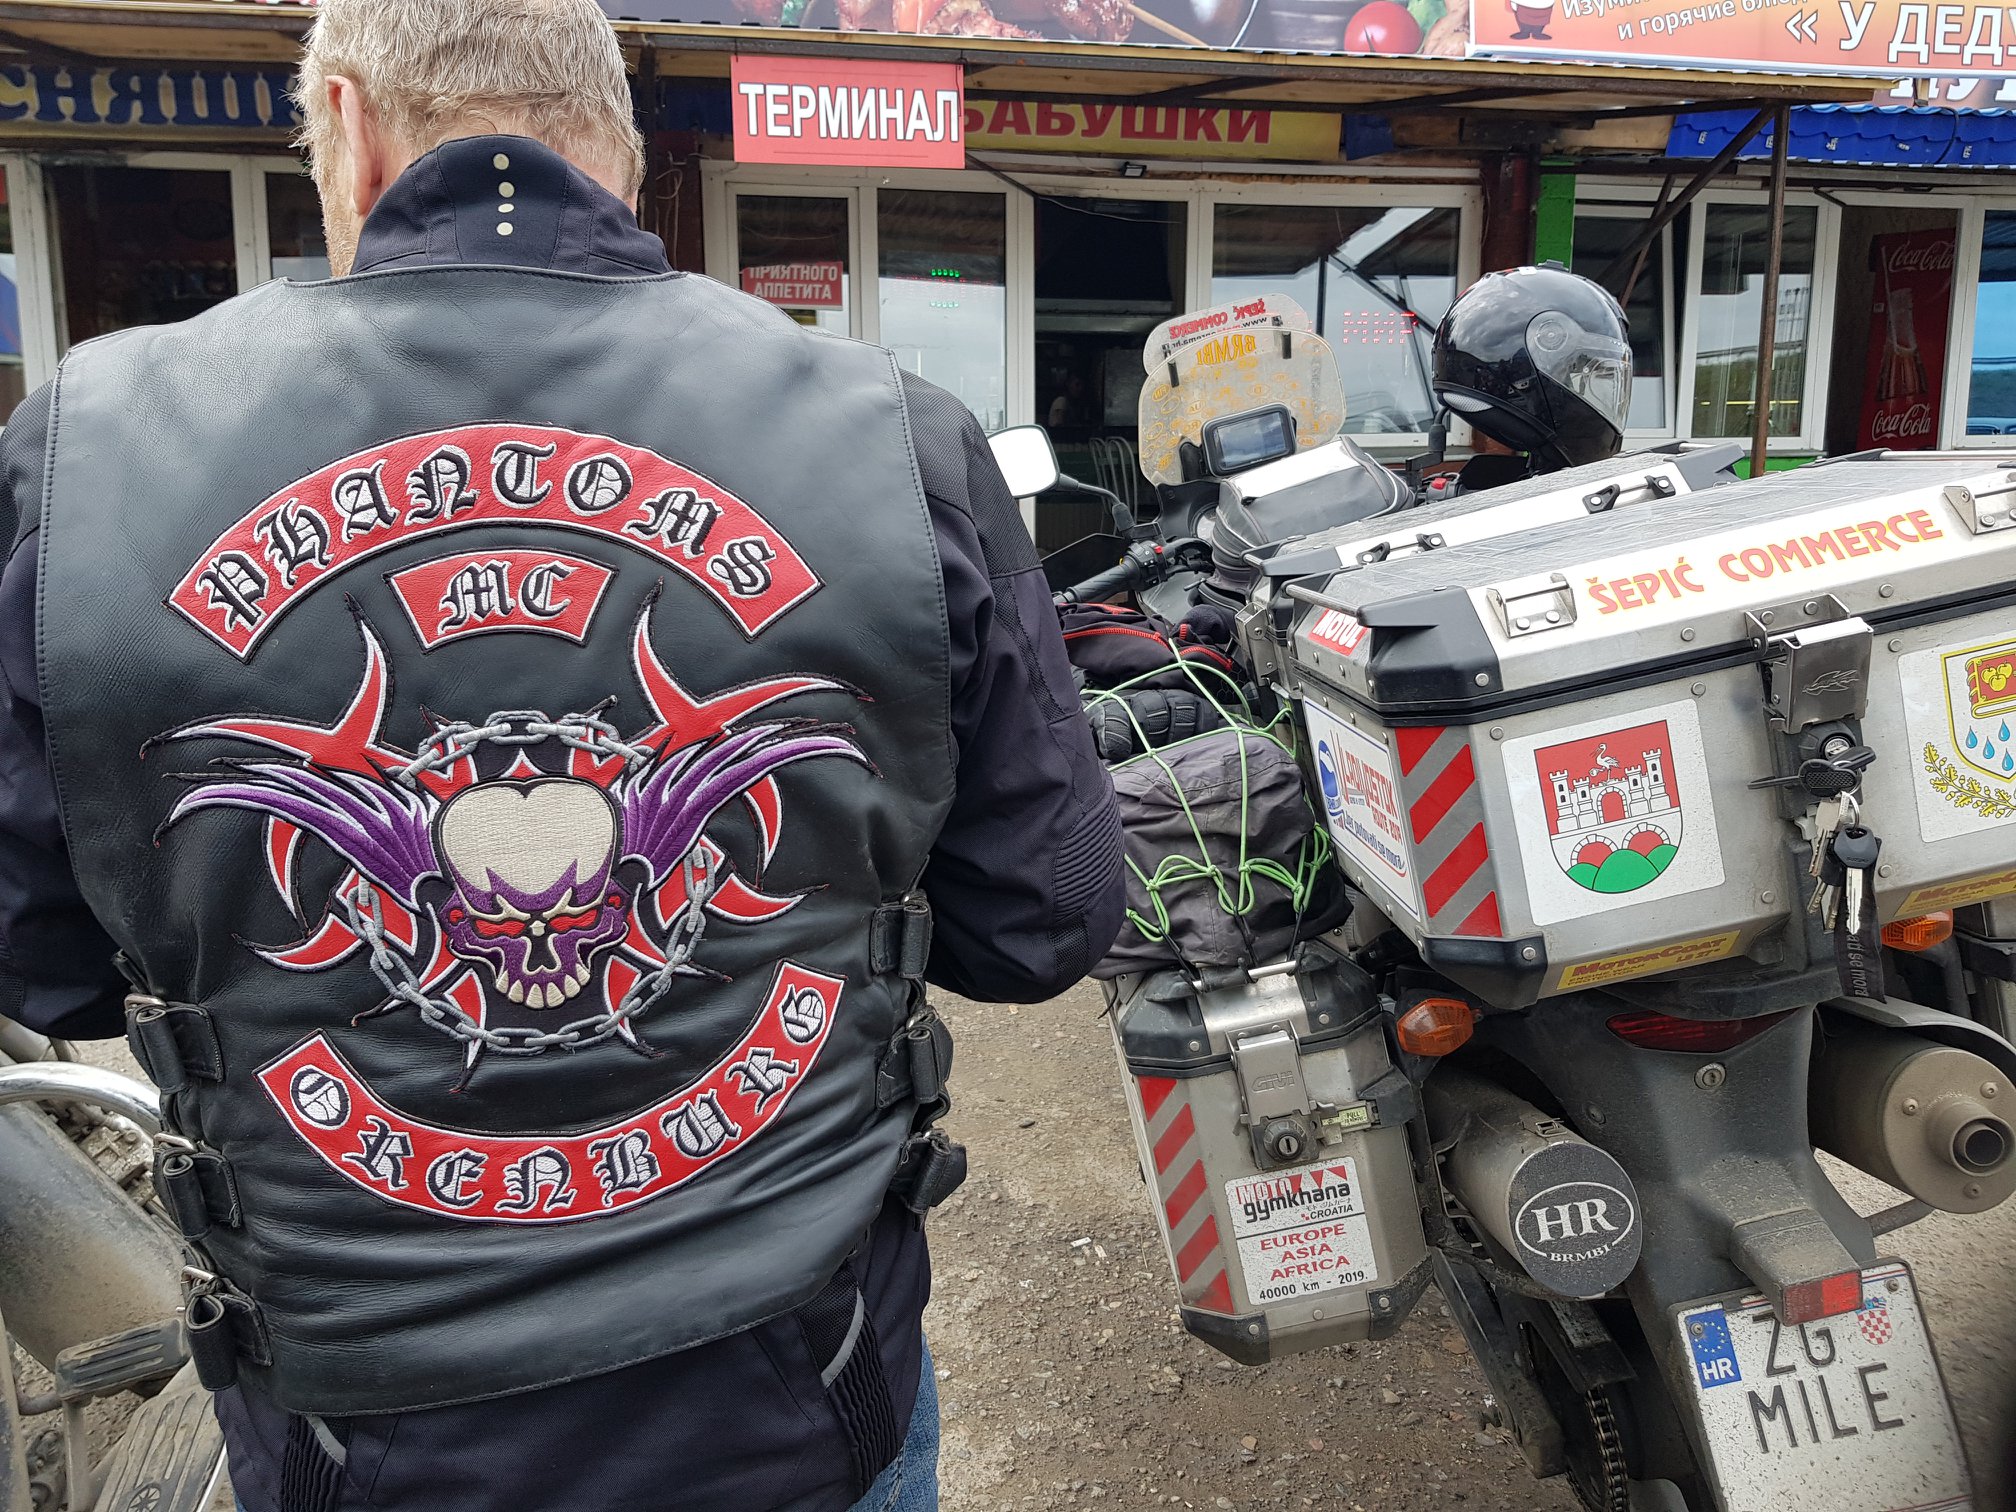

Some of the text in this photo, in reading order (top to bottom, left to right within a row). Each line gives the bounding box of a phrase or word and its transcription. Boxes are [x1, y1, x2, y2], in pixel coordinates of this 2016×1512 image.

[1617, 22, 1634, 41] и
[1639, 0, 1736, 36] горячие
[1838, 1, 1877, 50] У
[1887, 3, 2016, 66] ДЕД
[738, 82, 960, 142] ТЕРМИНАЛ
[749, 264, 838, 281] ПРИЯТНОГО
[753, 282, 832, 300] АППЕТИТА
[194, 440, 778, 632] PHANTOMS
[1586, 509, 1943, 615] ŠEPIĆ COMMERCE
[437, 562, 576, 635] MC
[1312, 609, 1364, 648] MOTUL
[289, 983, 829, 1214] ORENBURG
[1252, 1071, 1295, 1094] GIVI
[1237, 1177, 1292, 1204] MOTO
[1243, 1183, 1351, 1223] gymkhana
[1310, 1205, 1354, 1220] CROATIA
[1531, 1199, 1619, 1243] HR
[1260, 1223, 1347, 1251] EUROPE
[1281, 1243, 1333, 1263] ASIA
[1550, 1244, 1611, 1262] BRMBI
[1270, 1256, 1350, 1281] AFRICA
[1259, 1284, 1296, 1300] 40000
[1303, 1279, 1320, 1292] km
[1752, 1311, 1836, 1377] ZG
[1700, 1357, 1735, 1382] HR
[1747, 1362, 1905, 1454] MILE
